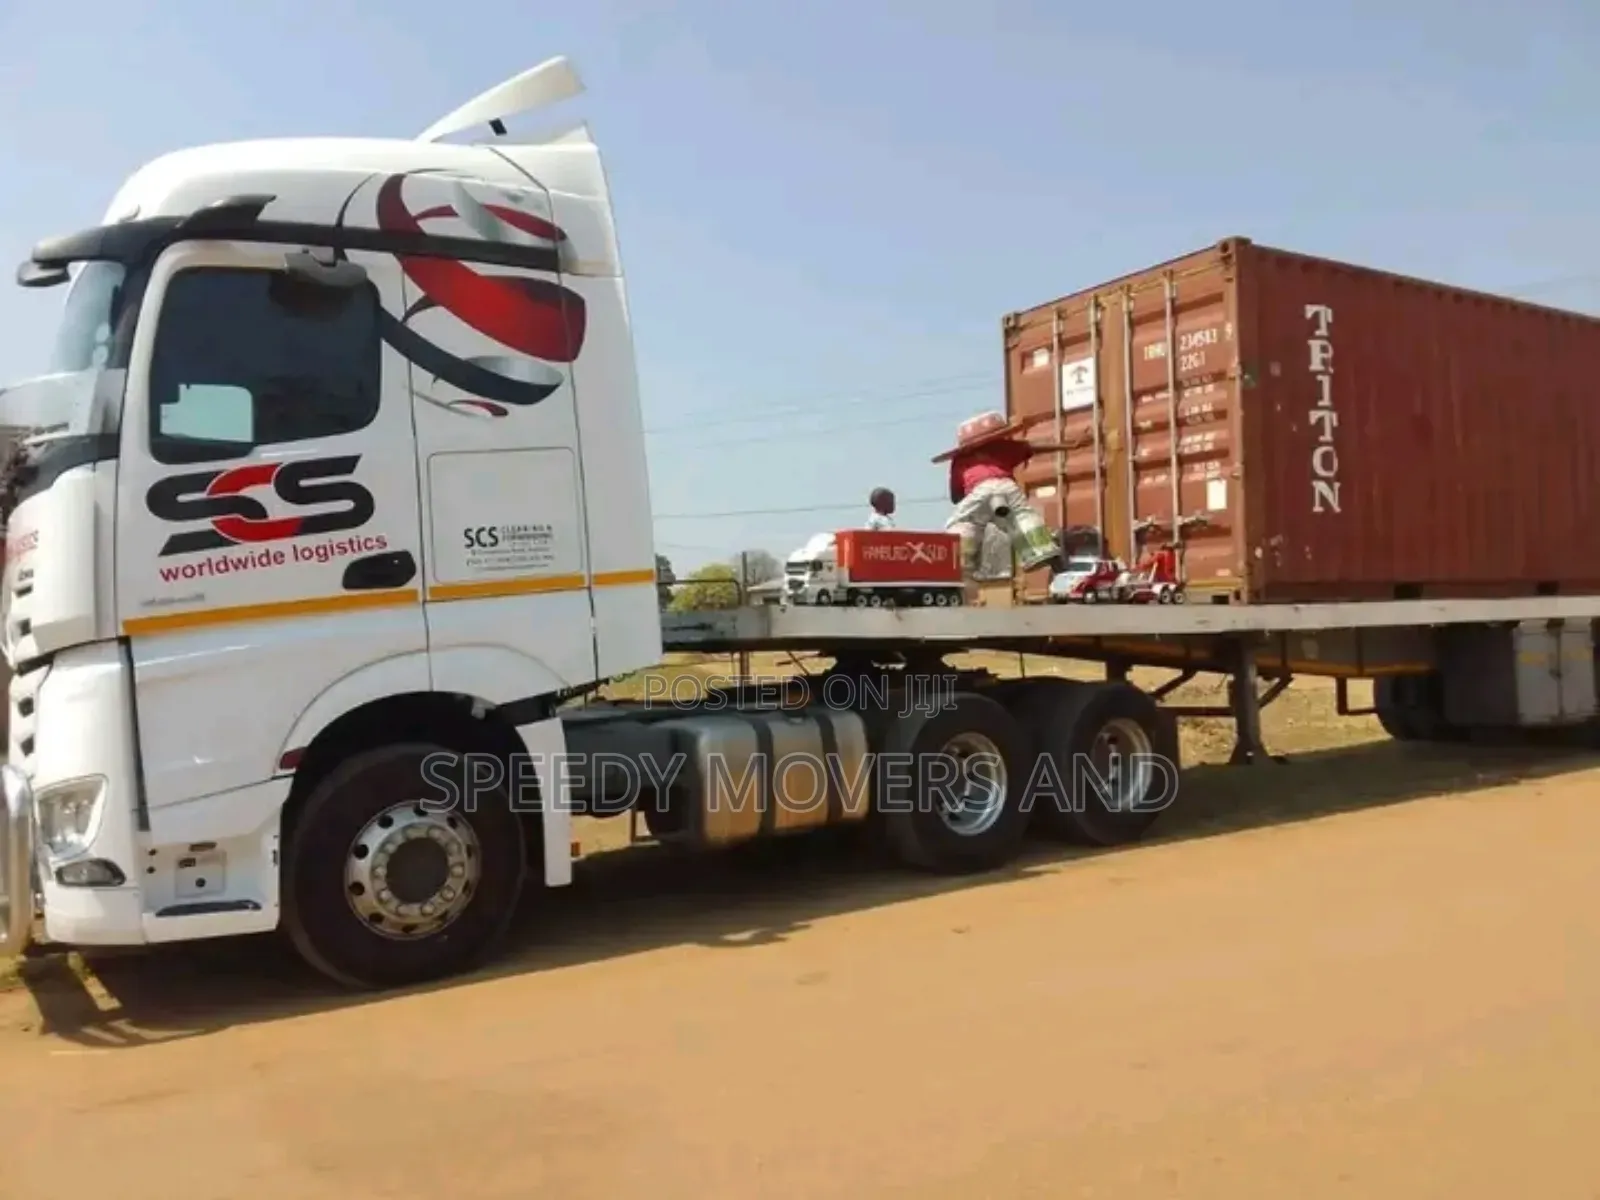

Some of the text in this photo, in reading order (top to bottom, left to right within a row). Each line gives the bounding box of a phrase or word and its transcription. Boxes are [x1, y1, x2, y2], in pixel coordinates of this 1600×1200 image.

[1304, 304, 1342, 513] TRITON
[145, 454, 375, 556] SCS
[464, 526, 499, 549] SCS
[159, 534, 388, 582] worldwide logistics
